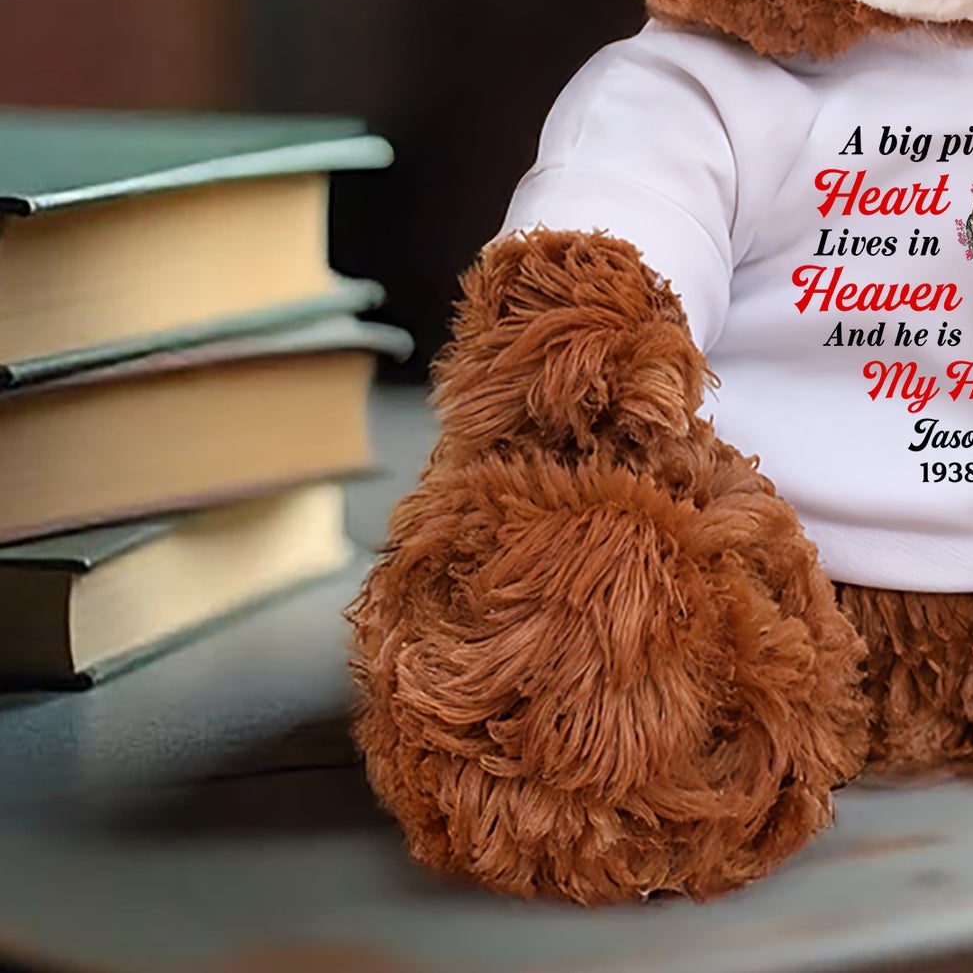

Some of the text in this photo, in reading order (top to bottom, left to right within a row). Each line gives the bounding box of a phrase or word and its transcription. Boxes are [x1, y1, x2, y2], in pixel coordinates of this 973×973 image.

[838, 125, 864, 155] A
[878, 125, 933, 163] big
[814, 168, 951, 218] Heart
[813, 228, 941, 257] Lives in
[791, 264, 963, 315] Heaven
[822, 321, 962, 347] And he is
[862, 360, 939, 414] My
